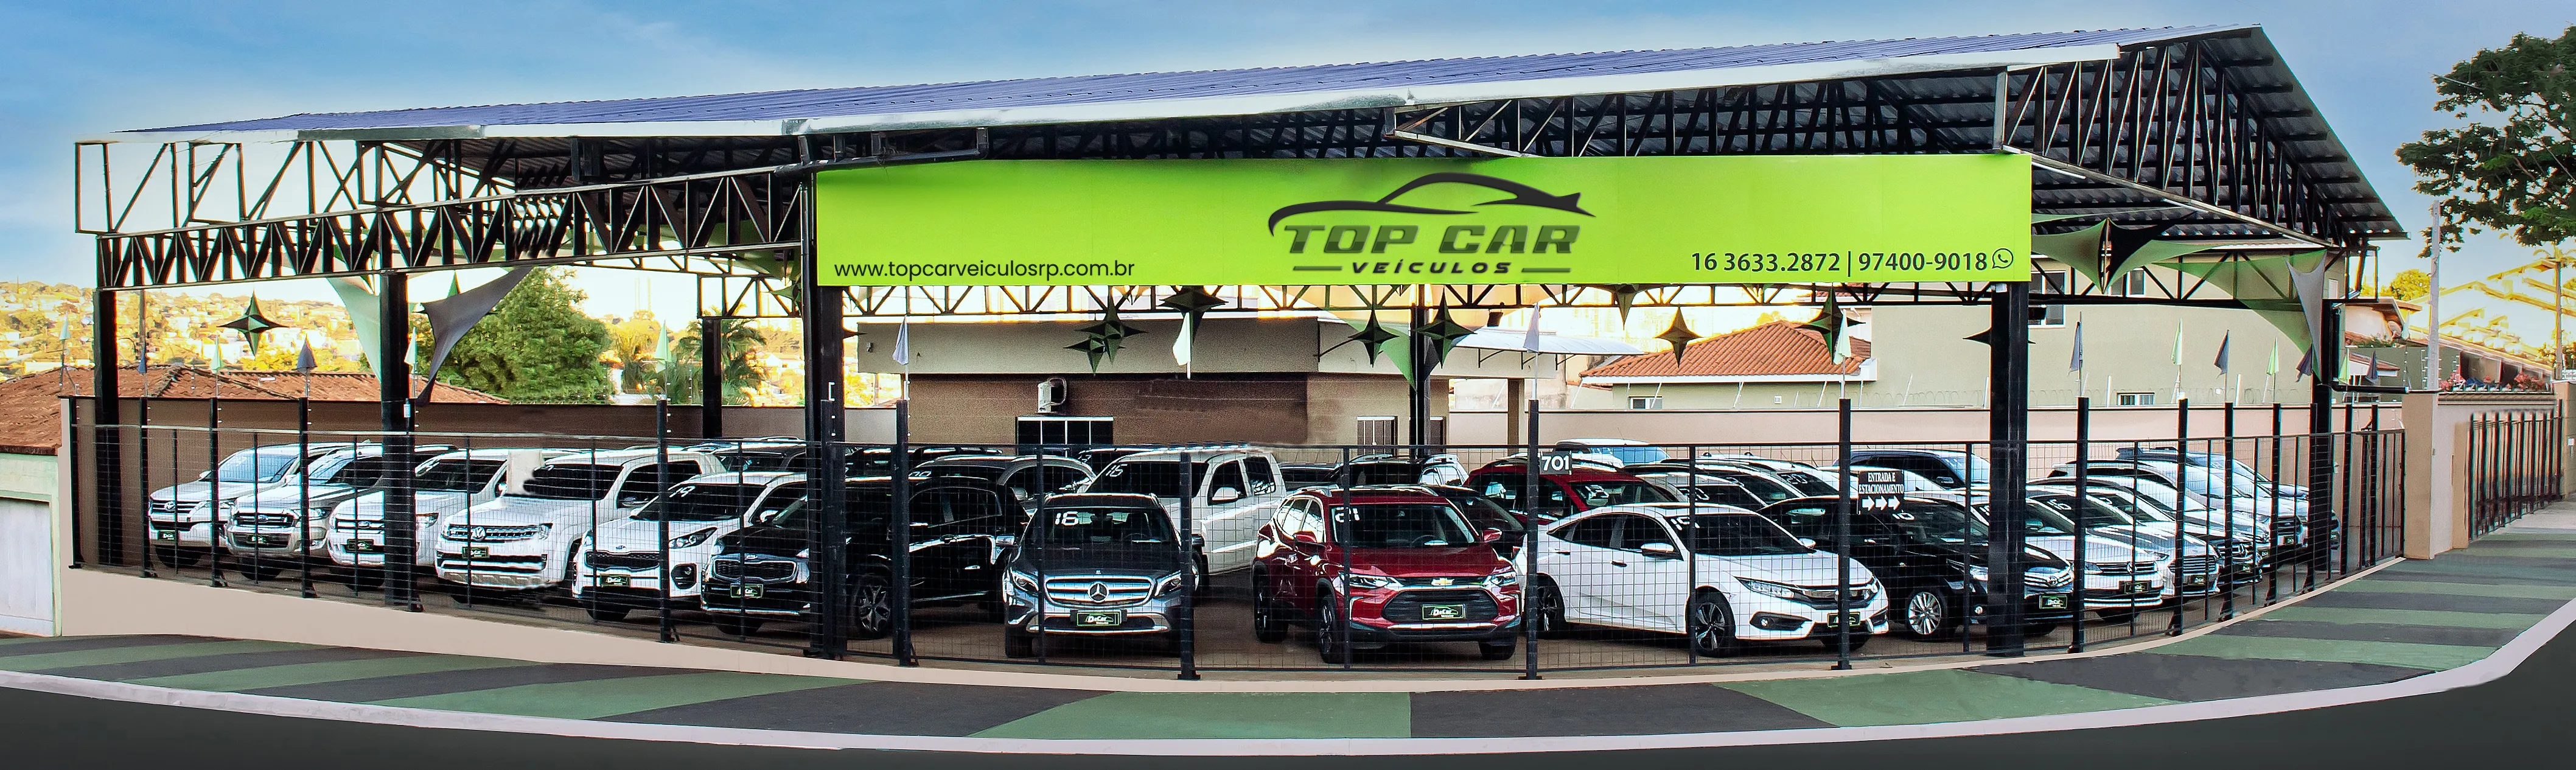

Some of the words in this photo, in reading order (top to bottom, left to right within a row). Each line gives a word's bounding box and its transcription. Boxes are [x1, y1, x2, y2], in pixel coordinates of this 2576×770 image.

[1284, 225, 1419, 254] TOP
[1439, 225, 1581, 254] CAR
[1350, 258, 1513, 274] VEÍCULOS
[1691, 252, 1718, 271] 16
[1723, 252, 1840, 272] 3633.2872
[1859, 252, 1988, 271] 97400-9018
[834, 259, 1136, 282] www.topcarveiculosrp.com.br
[1541, 455, 1569, 471] 701
[1867, 472, 1891, 482] ENTRADA
[1891, 472, 1896, 482] E
[669, 485, 696, 498] 19
[1858, 483, 1904, 494] ESTACIONAMENTO
[1055, 511, 1079, 527] 16
